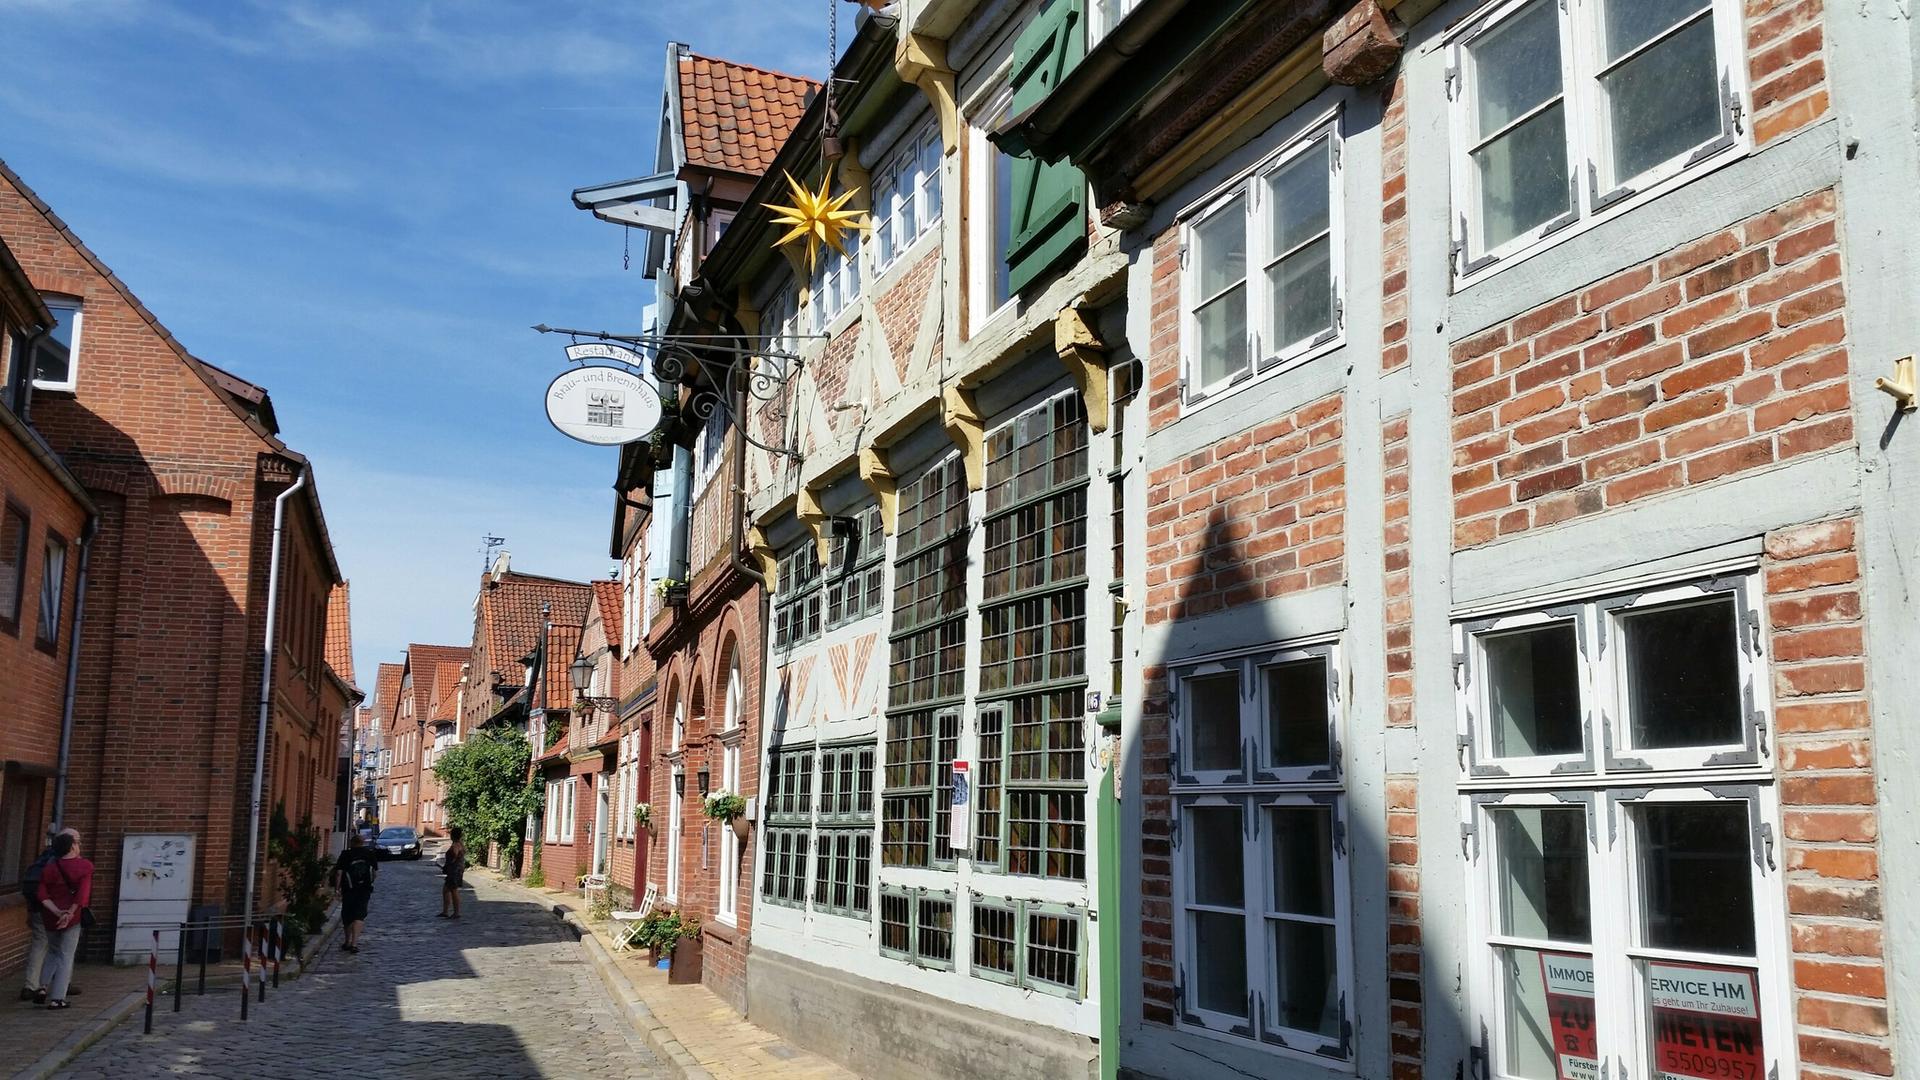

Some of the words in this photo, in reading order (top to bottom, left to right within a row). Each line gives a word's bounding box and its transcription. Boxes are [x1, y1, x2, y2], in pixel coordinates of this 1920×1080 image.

[573, 346, 637, 363] Restaurant
[553, 379, 581, 400] Brau-
[583, 371, 604, 383] und
[606, 372, 655, 409] Brennhaus
[1712, 981, 1746, 1001] HM
[1559, 999, 1591, 1031] ZU
[1662, 997, 1680, 1007] geht
[1681, 1000, 1695, 1008] um
[1696, 1000, 1708, 1010] Ihr
[1710, 1001, 1750, 1015] Zuhause!
[1666, 1050, 1758, 1080] 5509957
